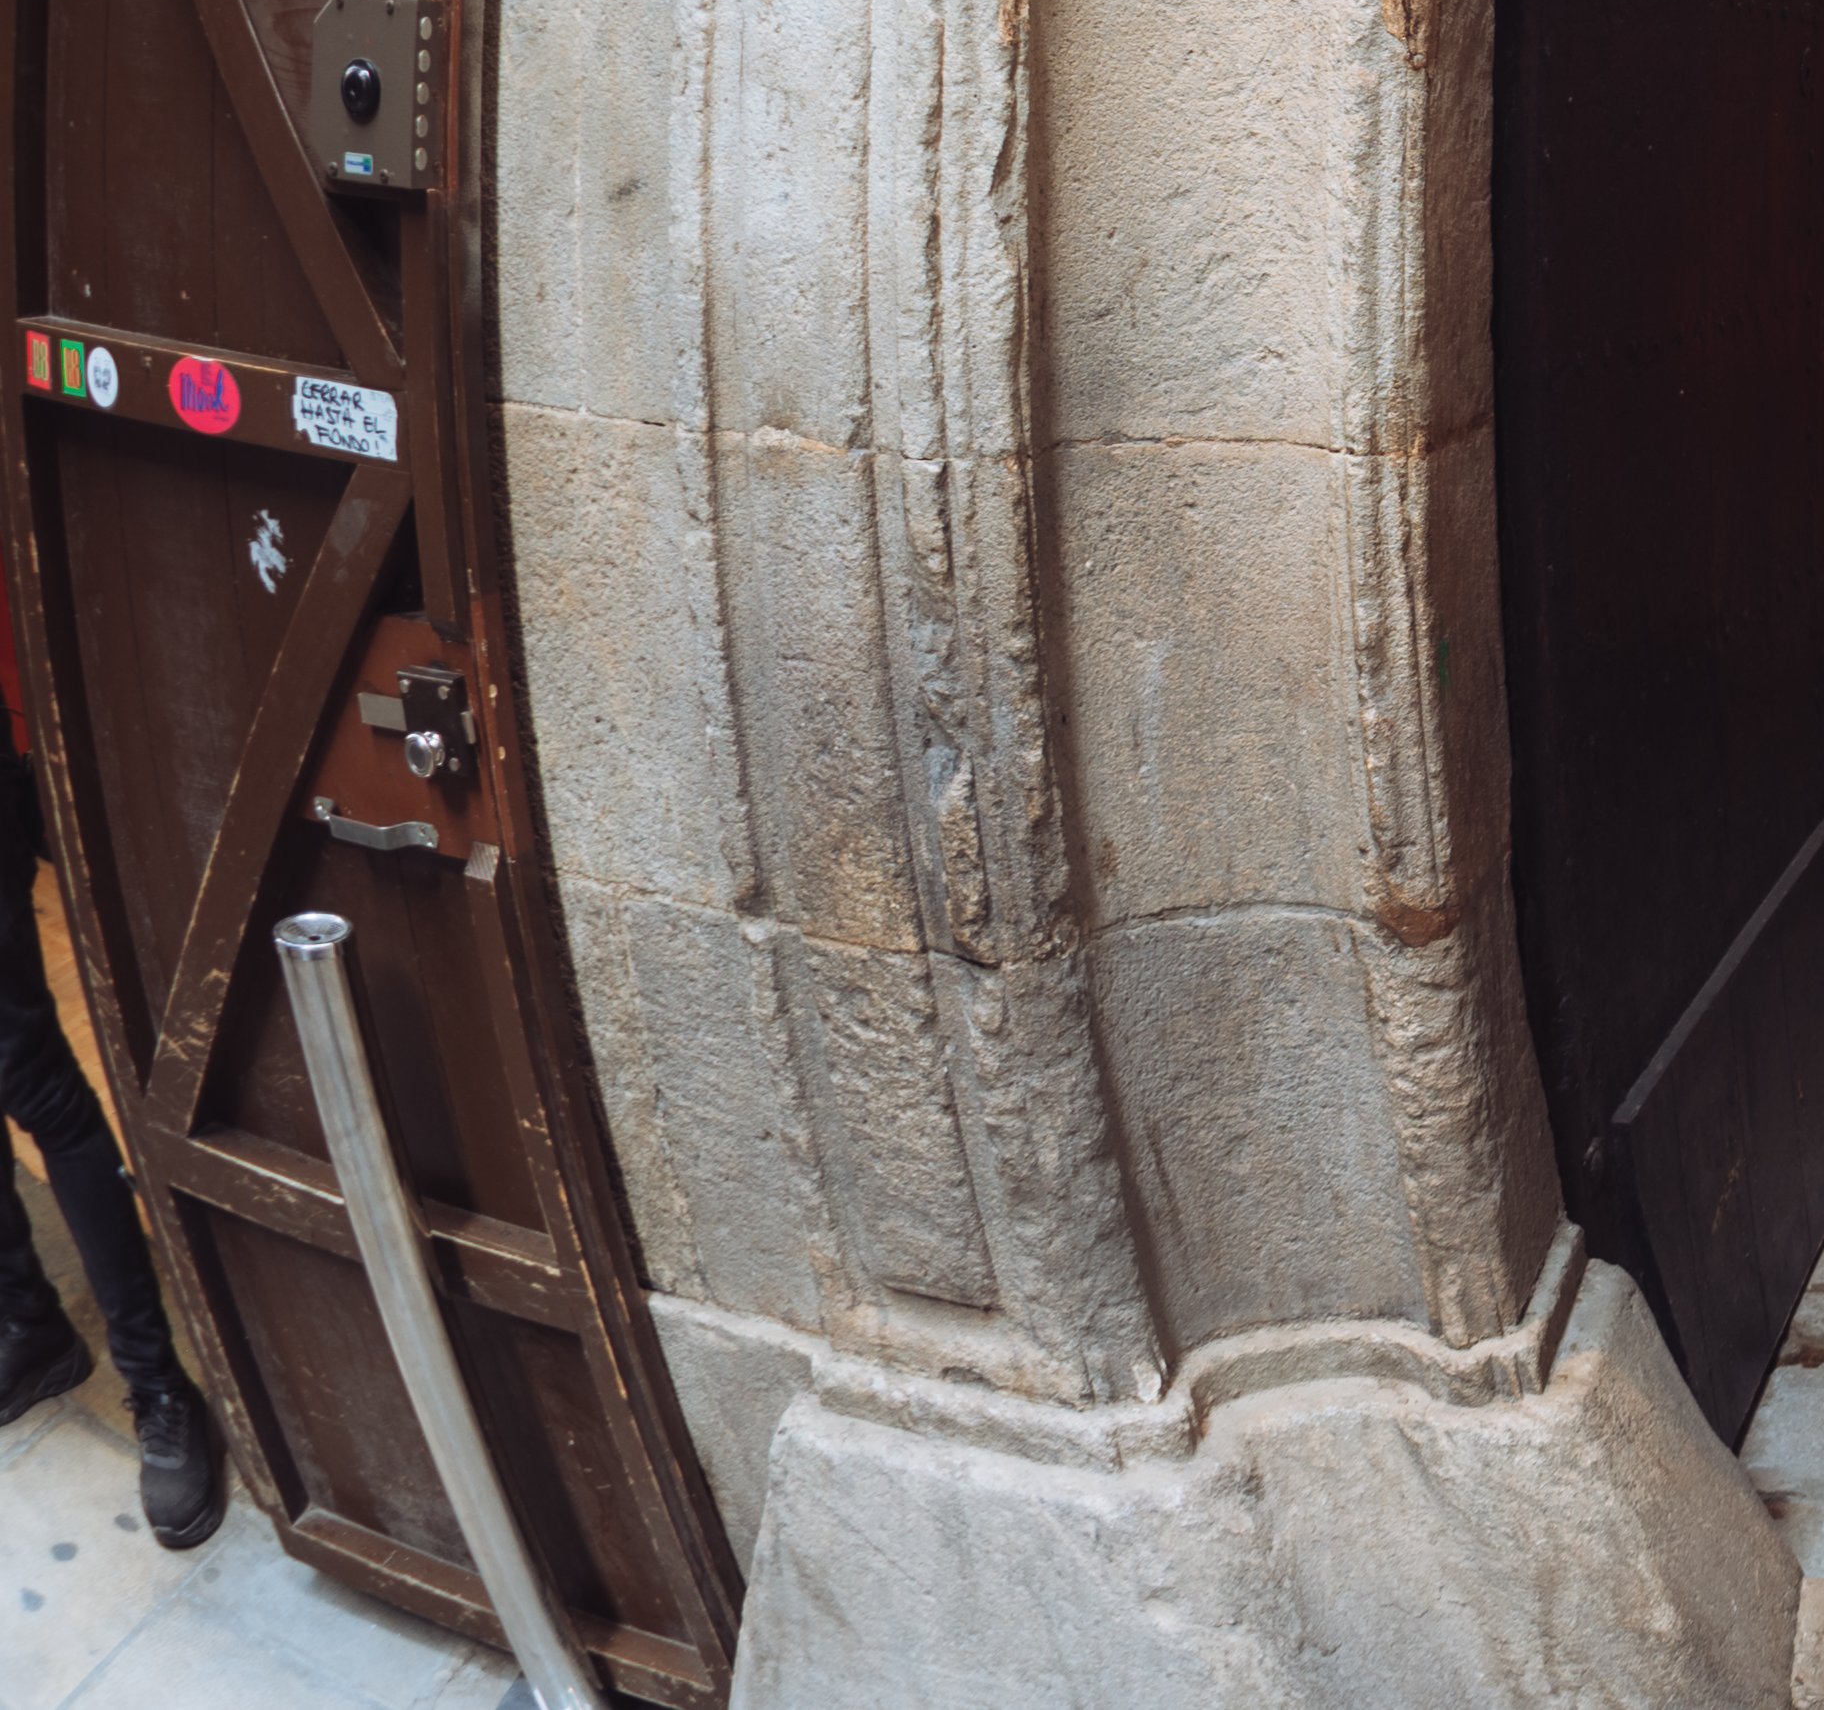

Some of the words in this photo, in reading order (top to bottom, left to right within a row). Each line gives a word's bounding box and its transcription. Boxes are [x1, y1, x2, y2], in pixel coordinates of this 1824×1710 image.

[301, 380, 365, 411] CERRAR
[301, 399, 355, 428] HASTA
[363, 416, 387, 433] EL
